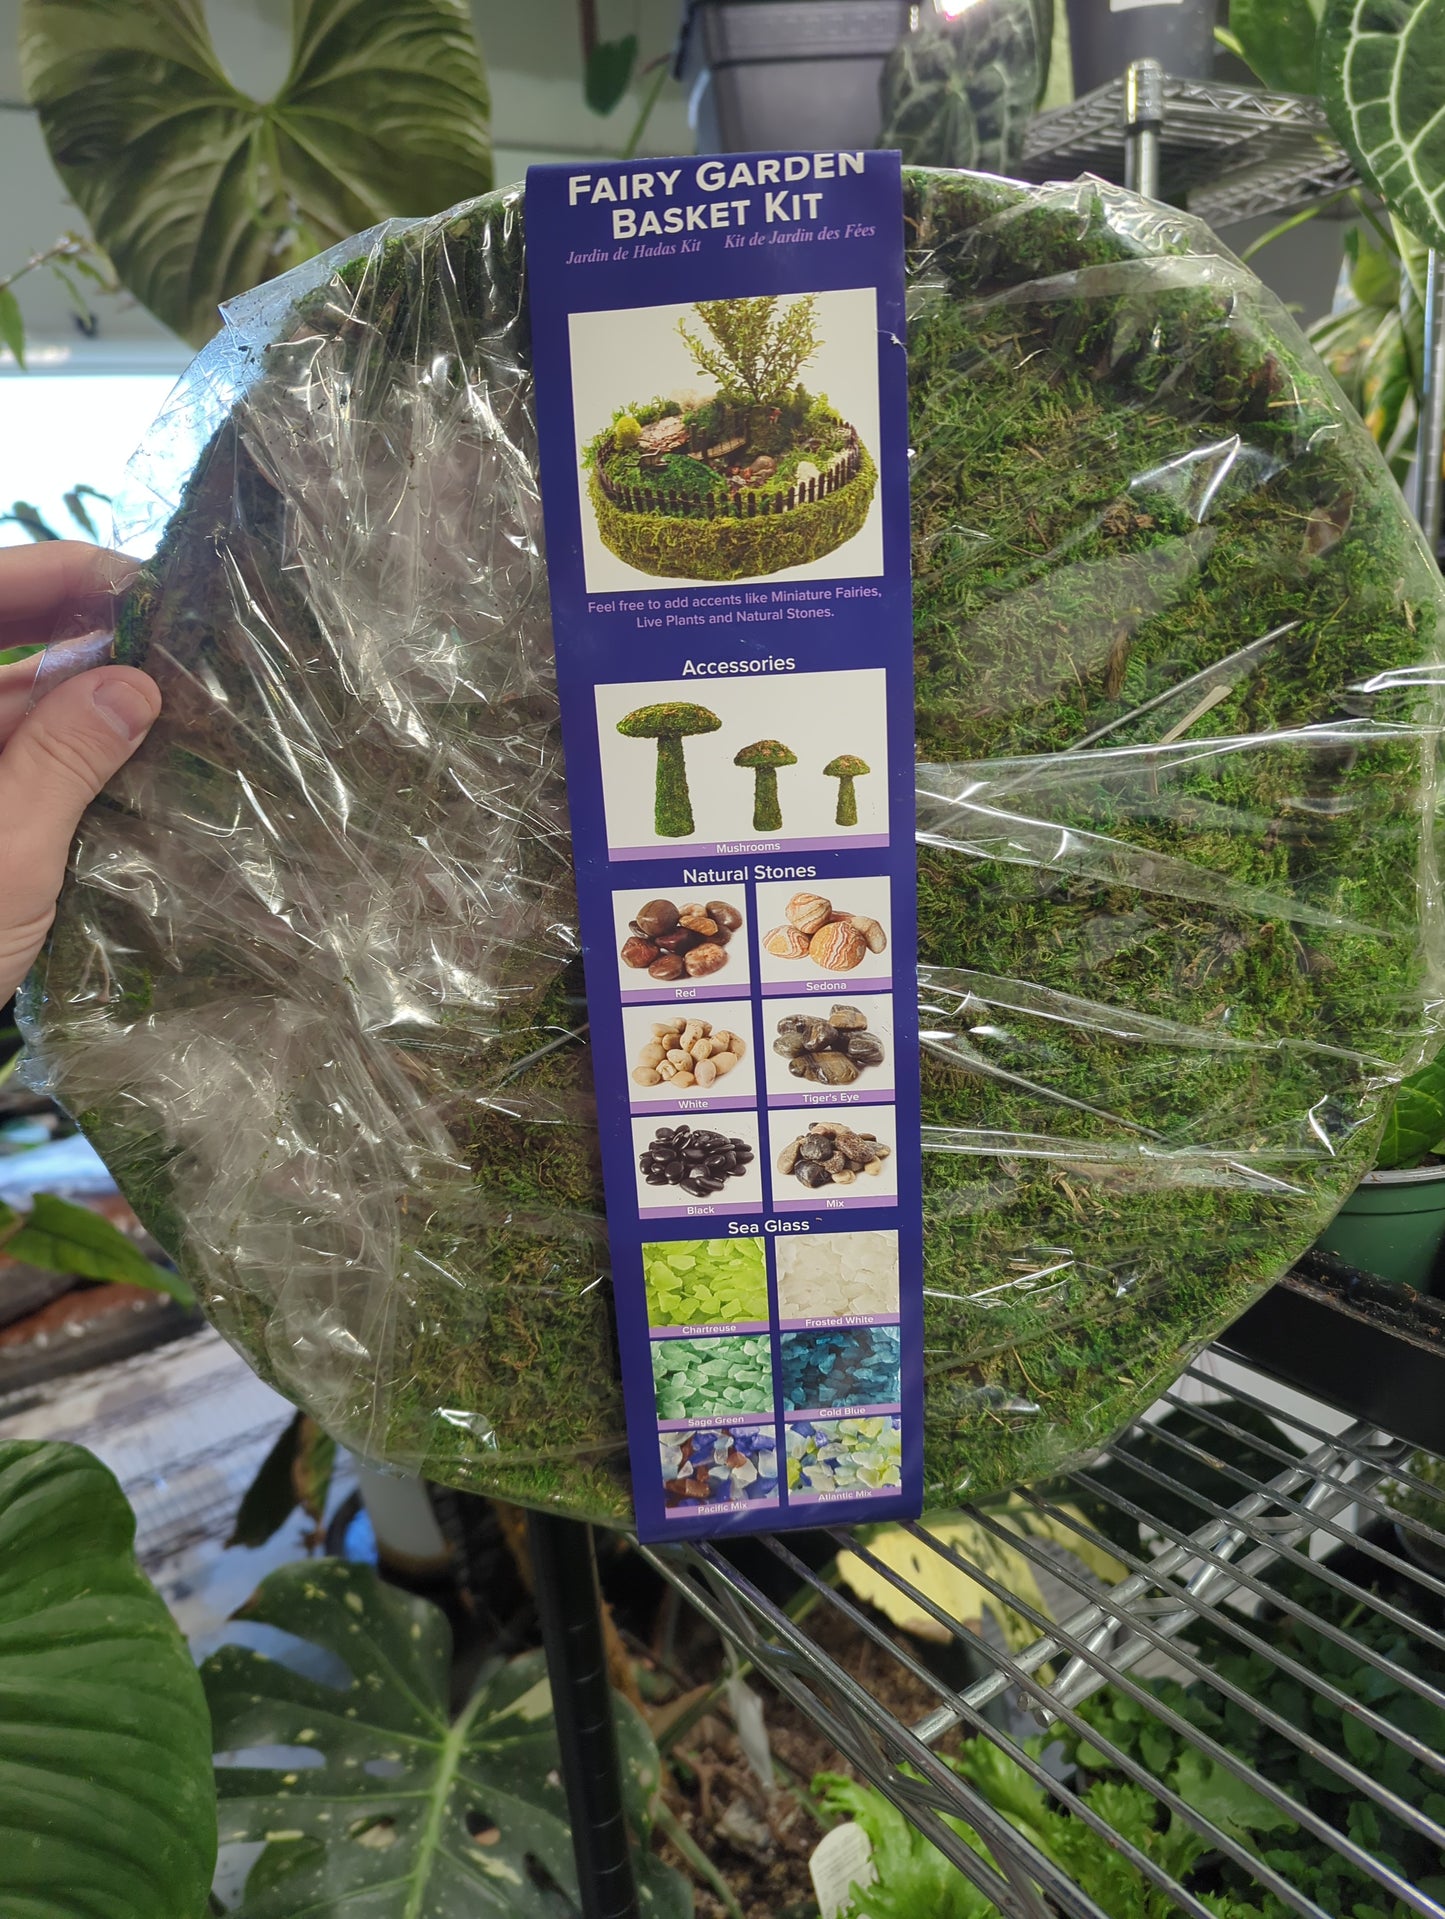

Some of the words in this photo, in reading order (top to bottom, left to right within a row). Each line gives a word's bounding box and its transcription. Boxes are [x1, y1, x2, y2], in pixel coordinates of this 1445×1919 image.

[724, 235, 746, 249] Kit
[749, 233, 766, 246] de
[769, 228, 813, 246] Jardin
[818, 226, 840, 241] des
[844, 222, 876, 238] Fées
[566, 249, 609, 264] Jardin
[613, 247, 629, 260] de
[633, 243, 676, 259] Hadas
[681, 239, 701, 253] Kit
[588, 601, 616, 613] Feel
[619, 599, 644, 611] free
[648, 599, 661, 610] to
[665, 596, 689, 609] add
[693, 595, 742, 607] accents
[745, 592, 768, 604] like
[772, 589, 832, 603] Miniature
[836, 586, 882, 599] Fairies,
[637, 616, 662, 628] Live
[666, 613, 705, 626] Plants
[709, 611, 733, 624] and
[737, 608, 783, 622] Natural
[787, 606, 834, 619] Stones.
[682, 655, 795, 676] Accessories
[716, 842, 780, 854] Mushrooms
[683, 867, 748, 884] Natural
[754, 865, 816, 880] Stones
[806, 981, 847, 991] Sedona
[676, 988, 696, 998] Red
[678, 1100, 708, 1108] White
[802, 1093, 837, 1103] Tiger's
[840, 1093, 860, 1102] Eye
[687, 1206, 714, 1214] Black
[826, 1200, 844, 1208] Mix
[728, 1222, 759, 1234] Sea
[764, 1220, 810, 1232] Glass
[805, 1317, 843, 1327] Frosted
[846, 1315, 874, 1325] White
[682, 1324, 736, 1334] Chartreuse
[819, 1408, 841, 1417] Cold
[844, 1406, 866, 1415] Blue
[688, 1418, 712, 1427] Sage
[715, 1415, 744, 1425] Green
[818, 1491, 853, 1502] Atlantic
[855, 1490, 872, 1499] Mix
[697, 1503, 729, 1514] Pacific
[731, 1502, 748, 1511] Mix
